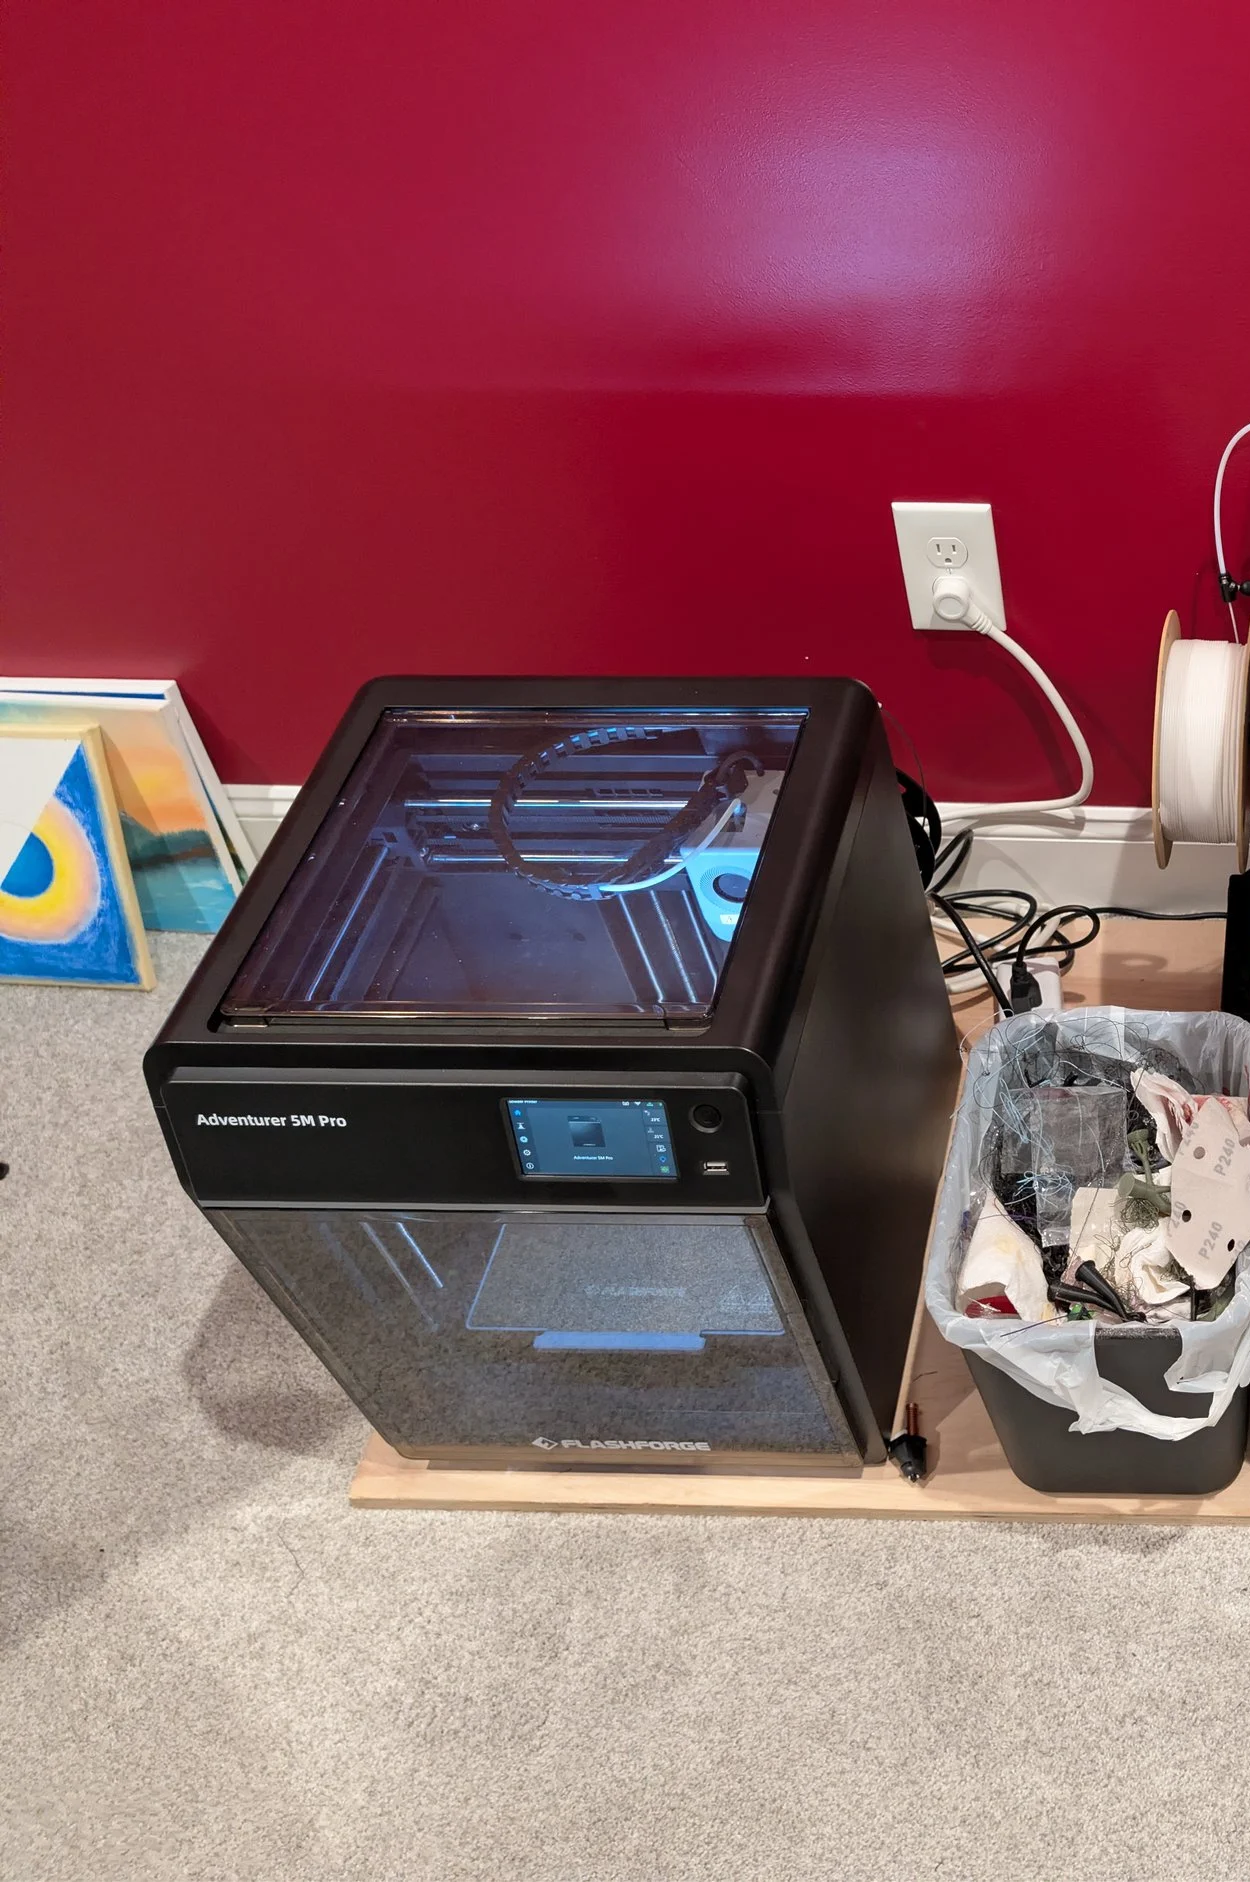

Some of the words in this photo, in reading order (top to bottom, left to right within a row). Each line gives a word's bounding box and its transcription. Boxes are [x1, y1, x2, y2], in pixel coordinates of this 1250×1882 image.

[196, 1113, 286, 1127] Adventurer
[291, 1115, 316, 1127] 5M
[319, 1115, 347, 1127] Pro
[1213, 1138, 1236, 1177] P240
[1198, 1221, 1223, 1260] P240
[560, 1439, 712, 1451] FLASHFORGE
